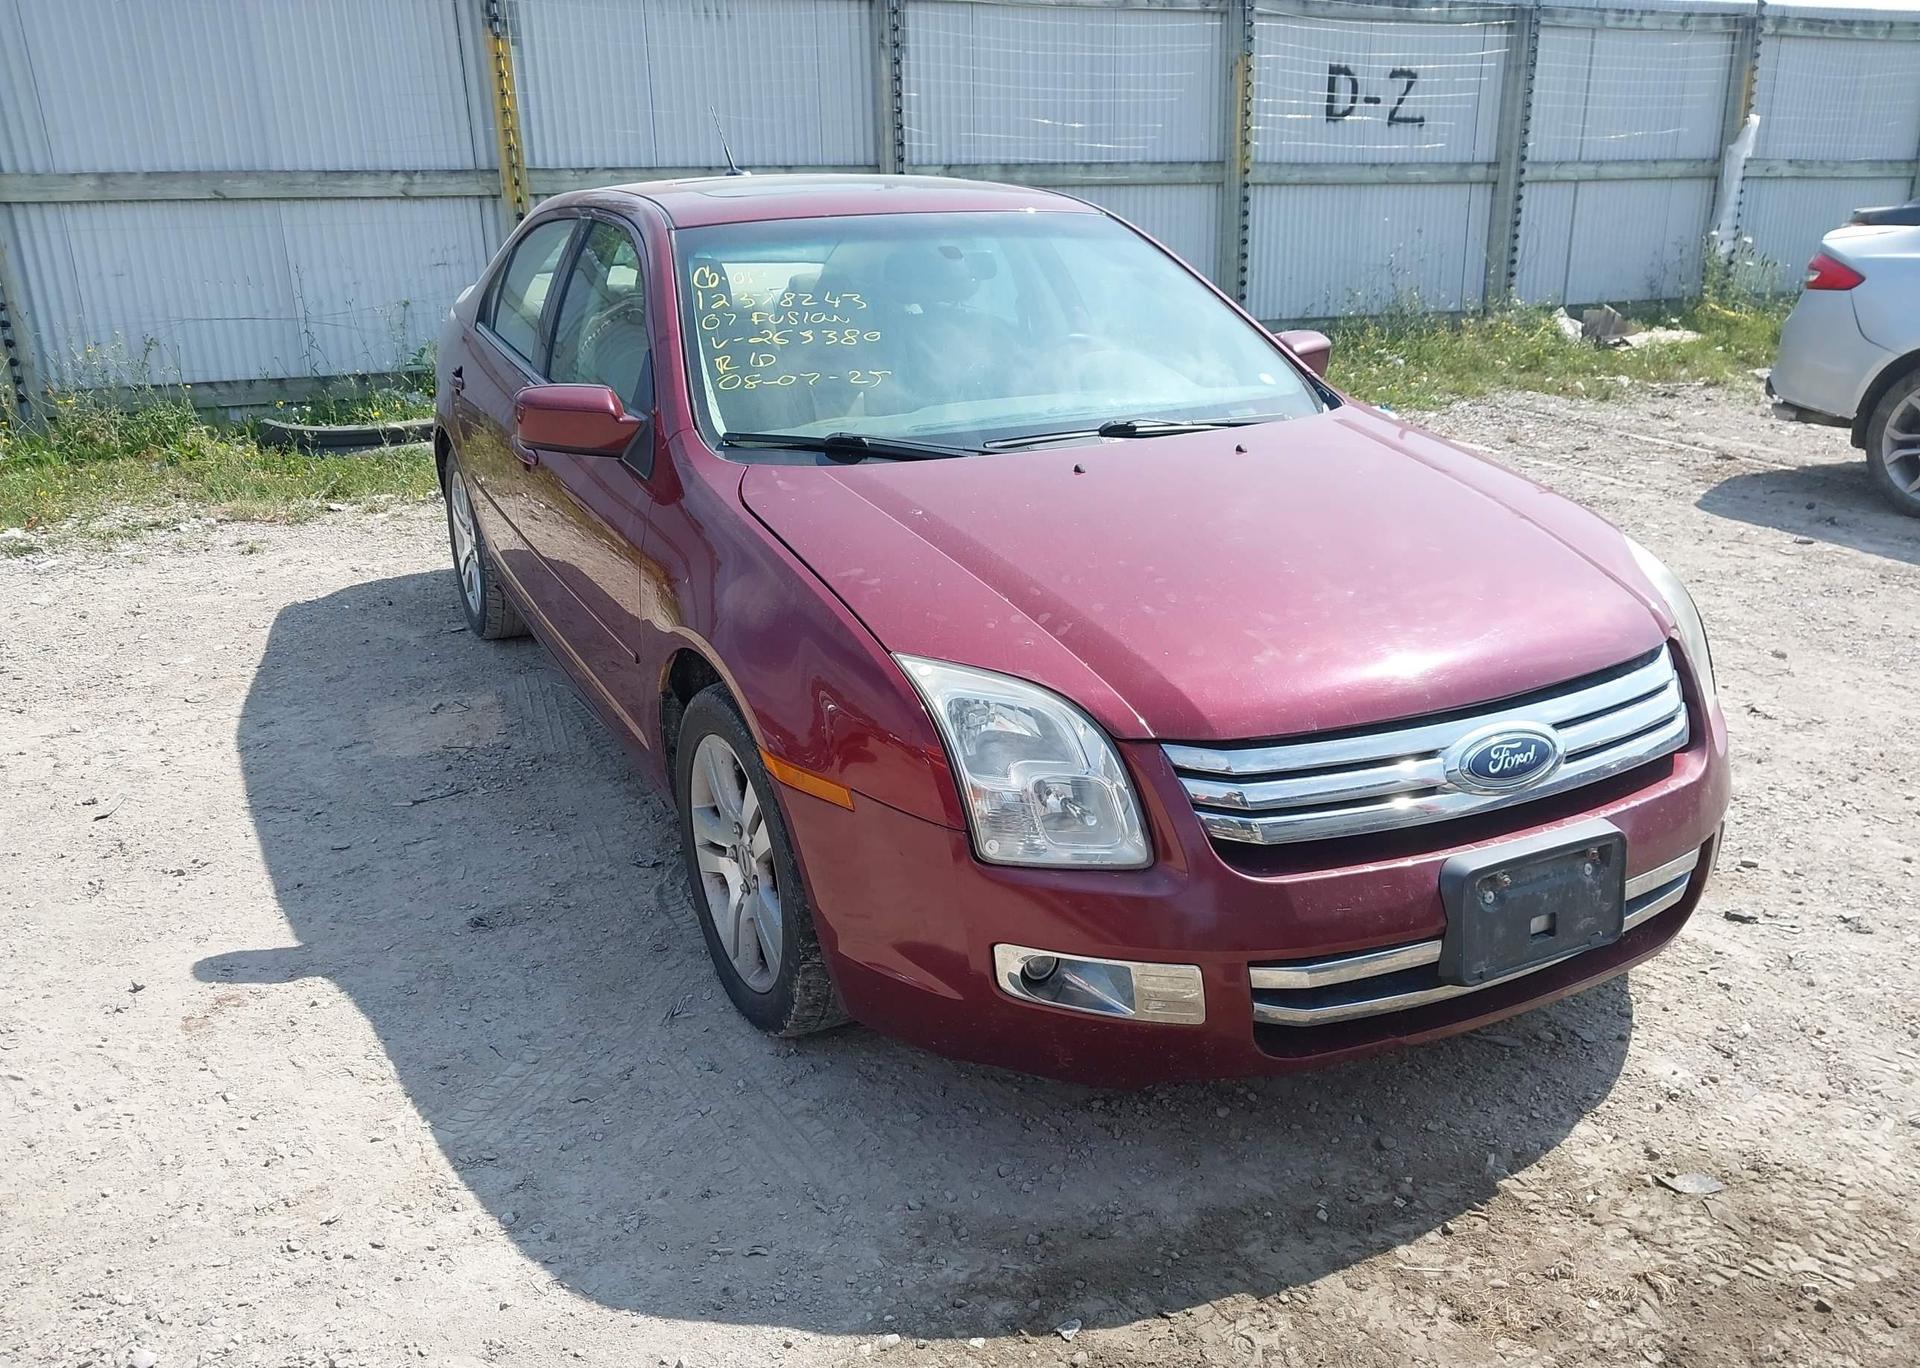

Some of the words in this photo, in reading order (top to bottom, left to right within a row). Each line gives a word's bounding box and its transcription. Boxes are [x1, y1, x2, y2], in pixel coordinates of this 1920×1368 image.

[702, 313, 737, 330] 07
[716, 370, 892, 391] 08-07-25
[1488, 741, 1537, 774] Ford
